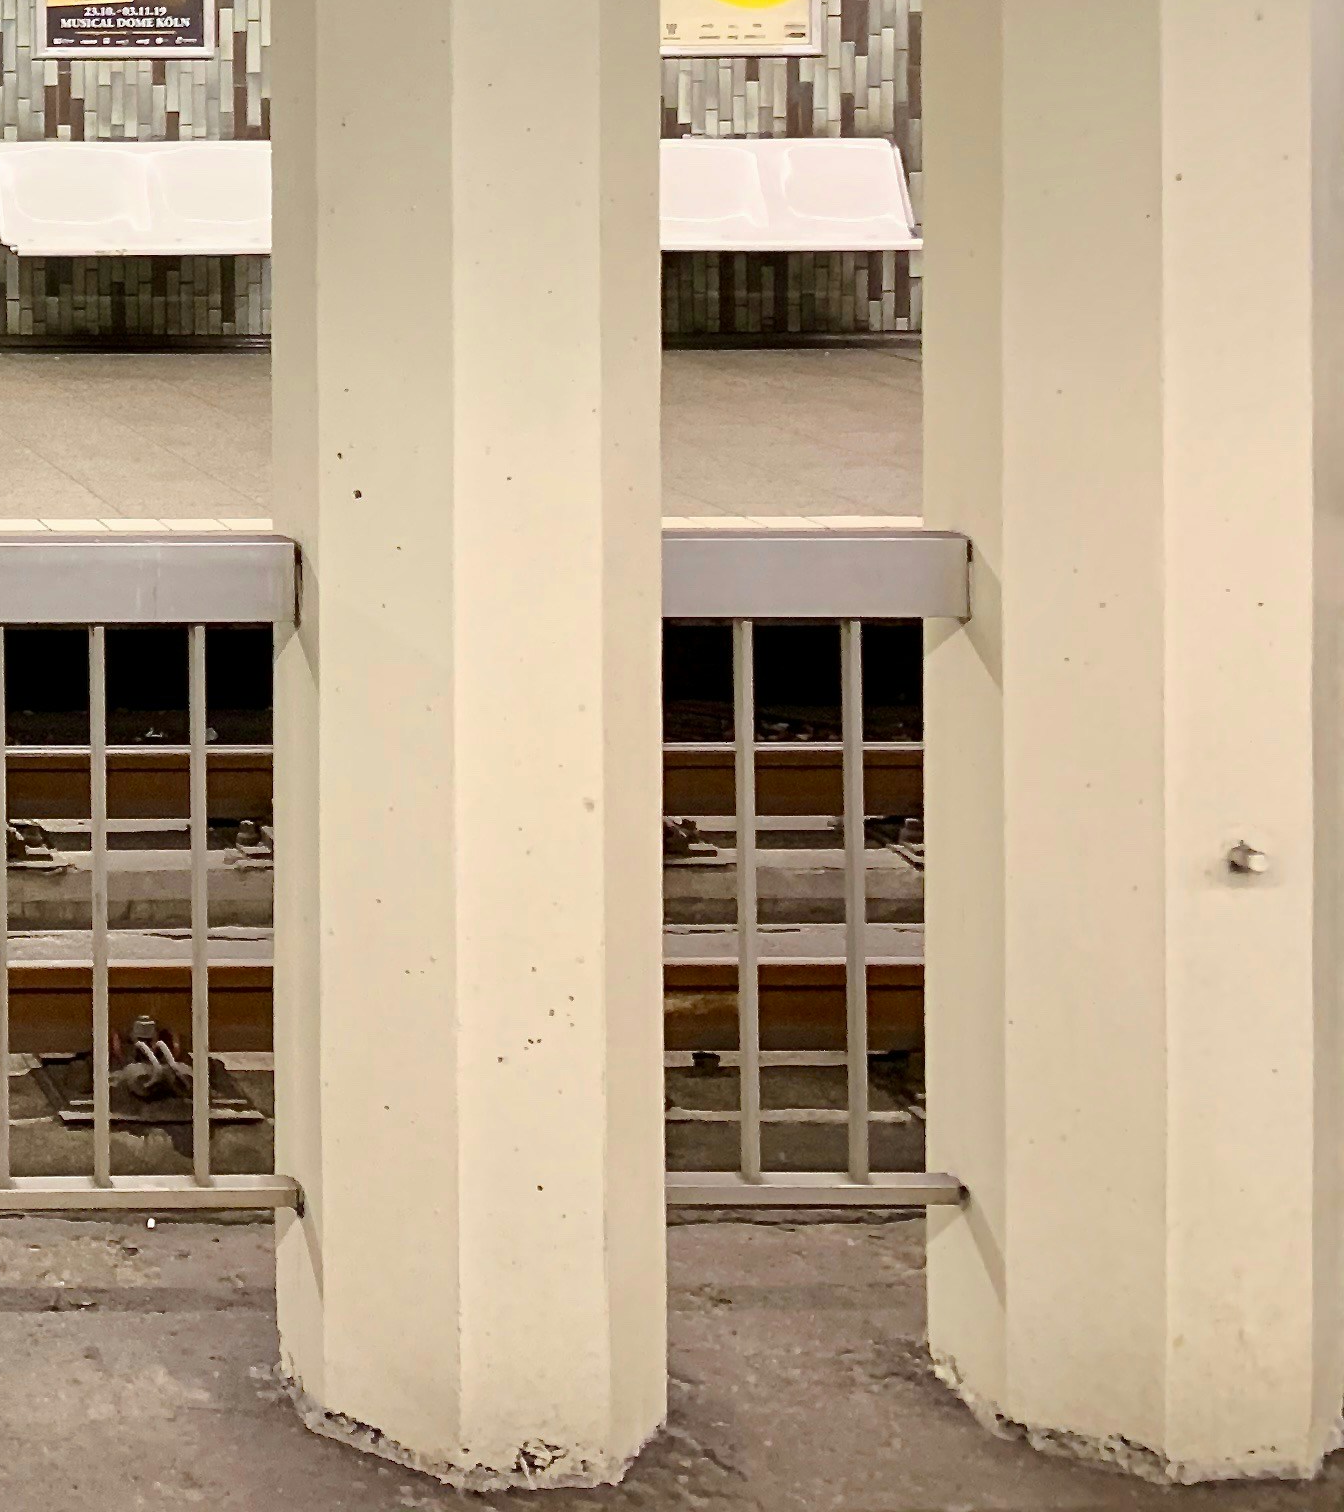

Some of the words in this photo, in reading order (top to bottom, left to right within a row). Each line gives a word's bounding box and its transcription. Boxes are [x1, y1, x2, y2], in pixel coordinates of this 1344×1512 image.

[60, 17, 114, 28] MUSICAL
[116, 17, 154, 28] DOME
[156, 16, 191, 28] KÖLN
